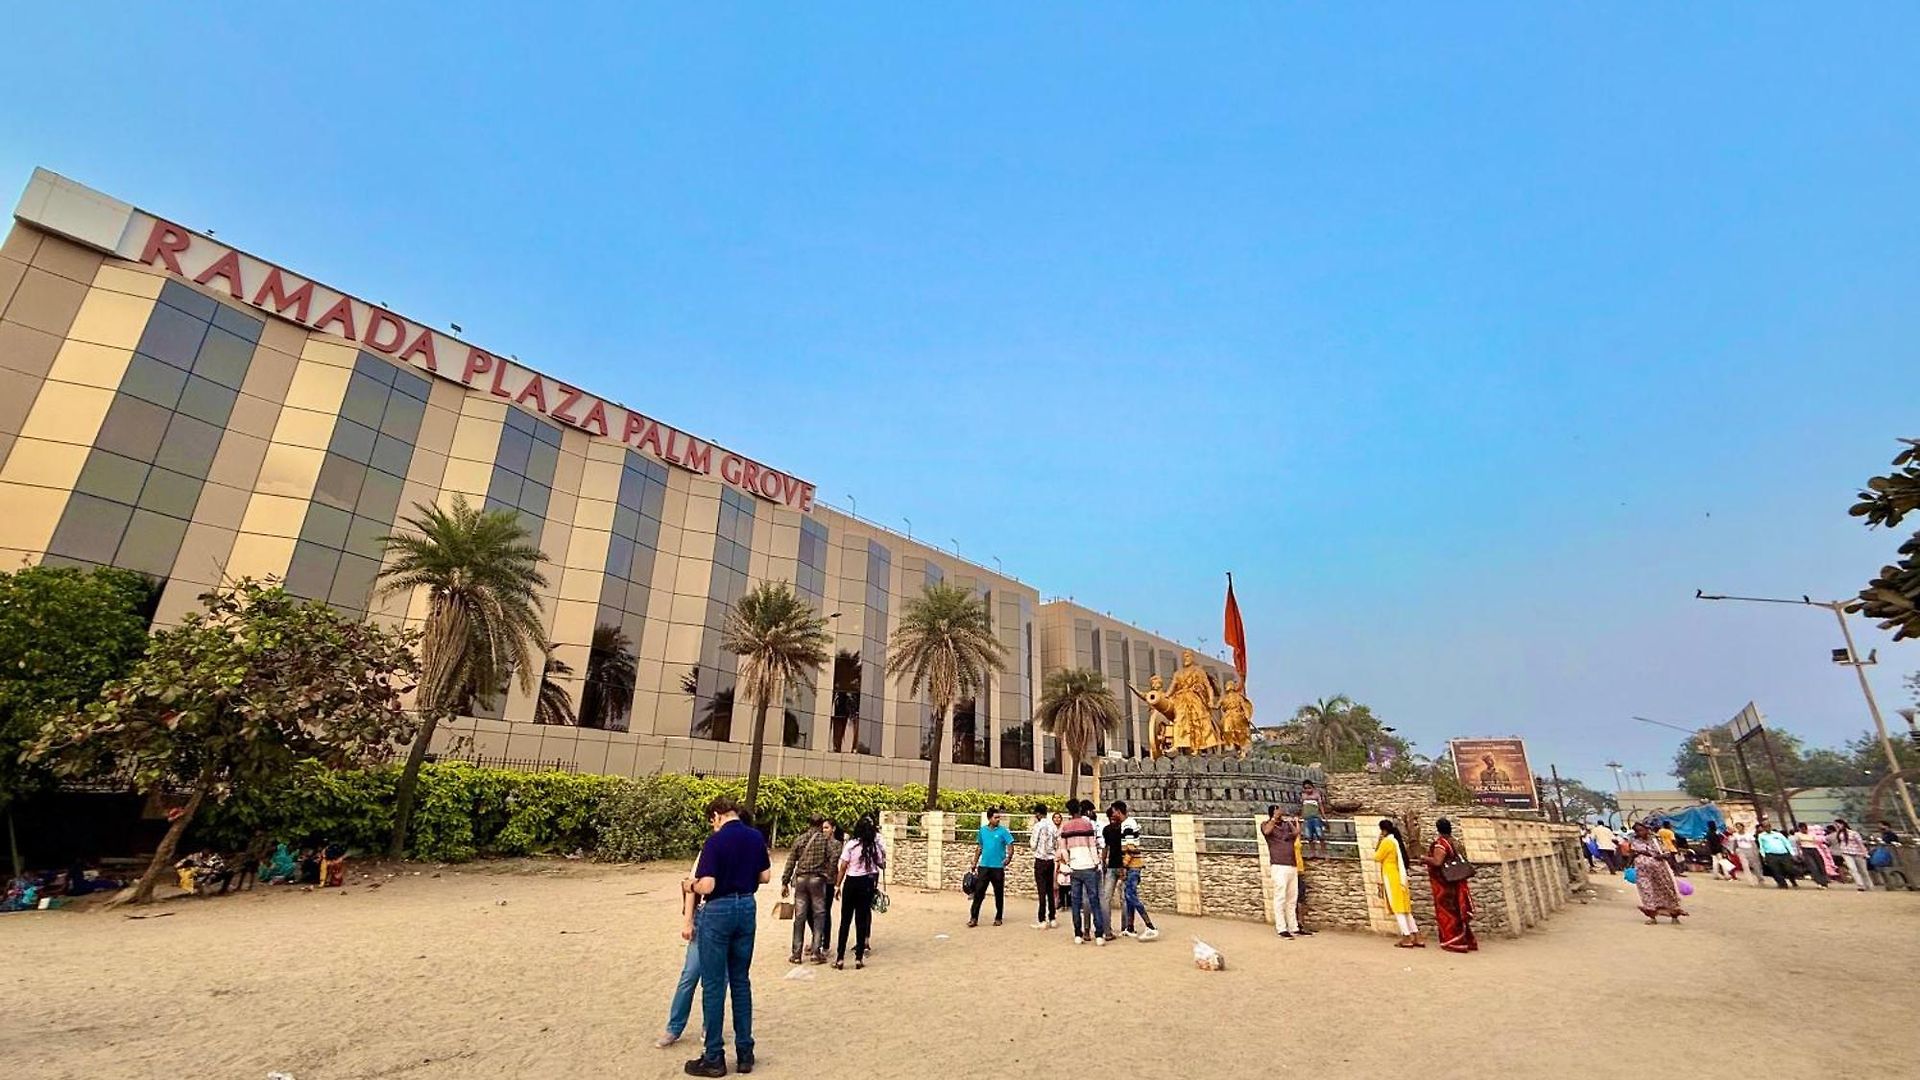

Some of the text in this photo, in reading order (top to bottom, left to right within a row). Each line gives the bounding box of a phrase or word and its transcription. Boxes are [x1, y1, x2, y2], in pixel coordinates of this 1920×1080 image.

[139, 219, 814, 512] RAMADA PLAZA PALM GROVE
